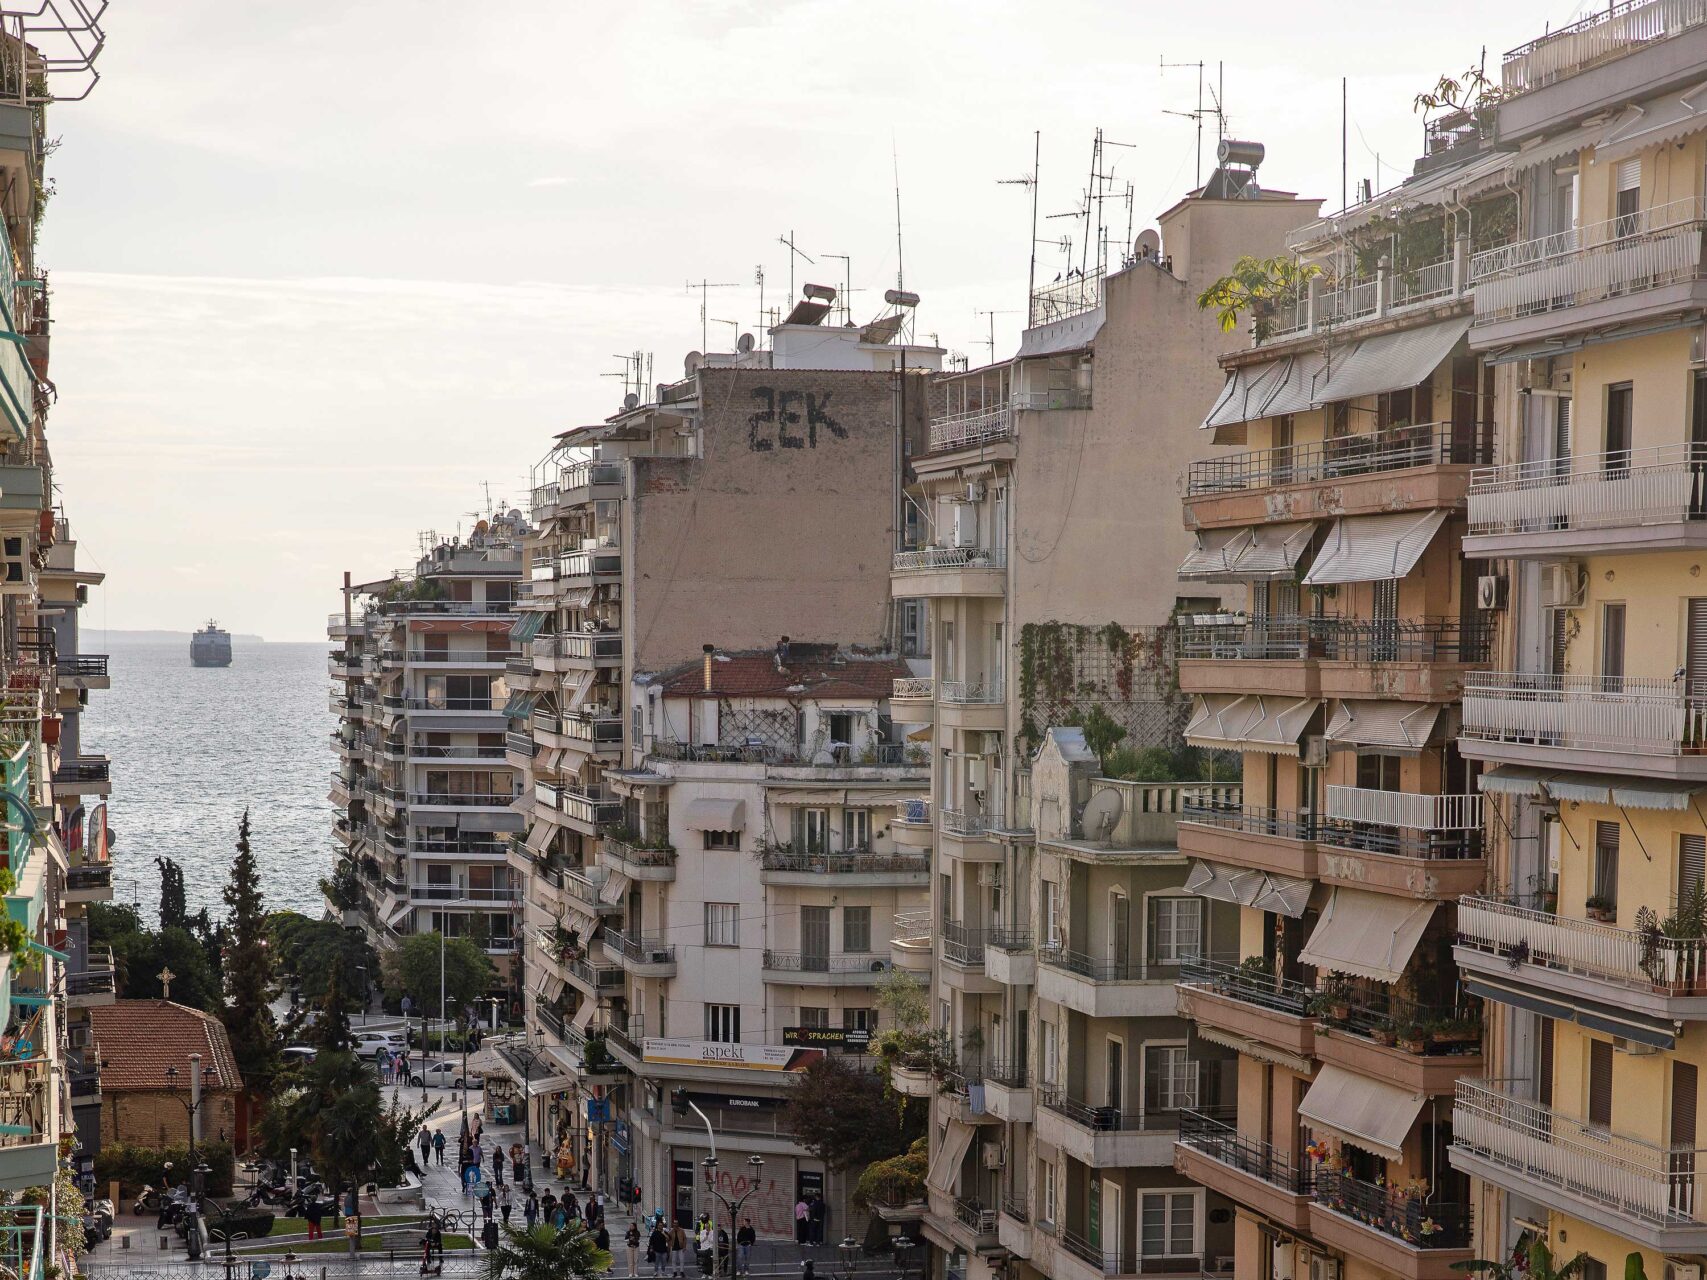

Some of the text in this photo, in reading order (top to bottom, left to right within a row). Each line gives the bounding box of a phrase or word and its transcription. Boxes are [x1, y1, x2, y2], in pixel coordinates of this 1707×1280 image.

[808, 1032, 844, 1040] SPRACHEN
[702, 1044, 744, 1060] aspekt
[729, 1099, 759, 1107] EUROBANK
